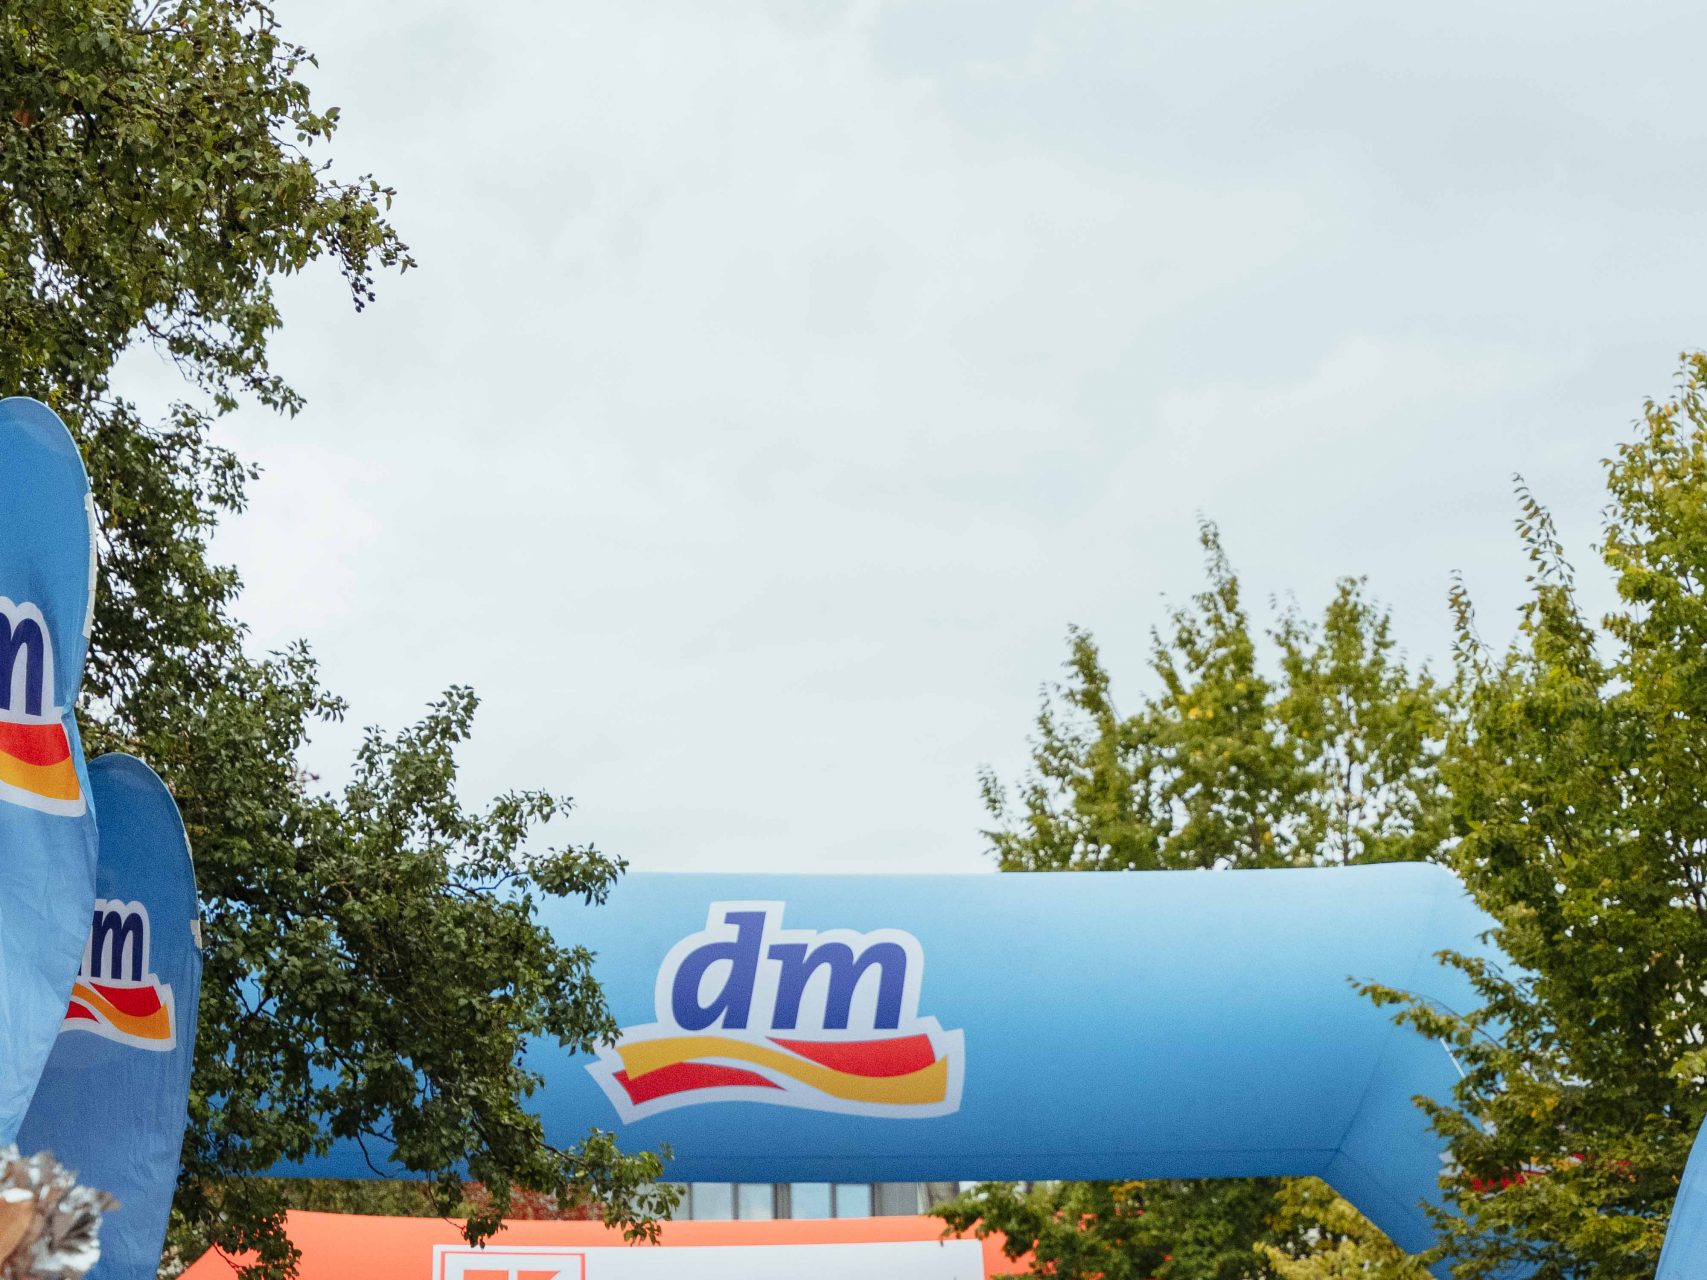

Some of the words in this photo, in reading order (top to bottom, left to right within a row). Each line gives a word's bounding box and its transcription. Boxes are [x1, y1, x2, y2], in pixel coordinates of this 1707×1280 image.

[0, 612, 44, 716] m
[78, 910, 144, 981] m
[671, 911, 907, 1031] dm
